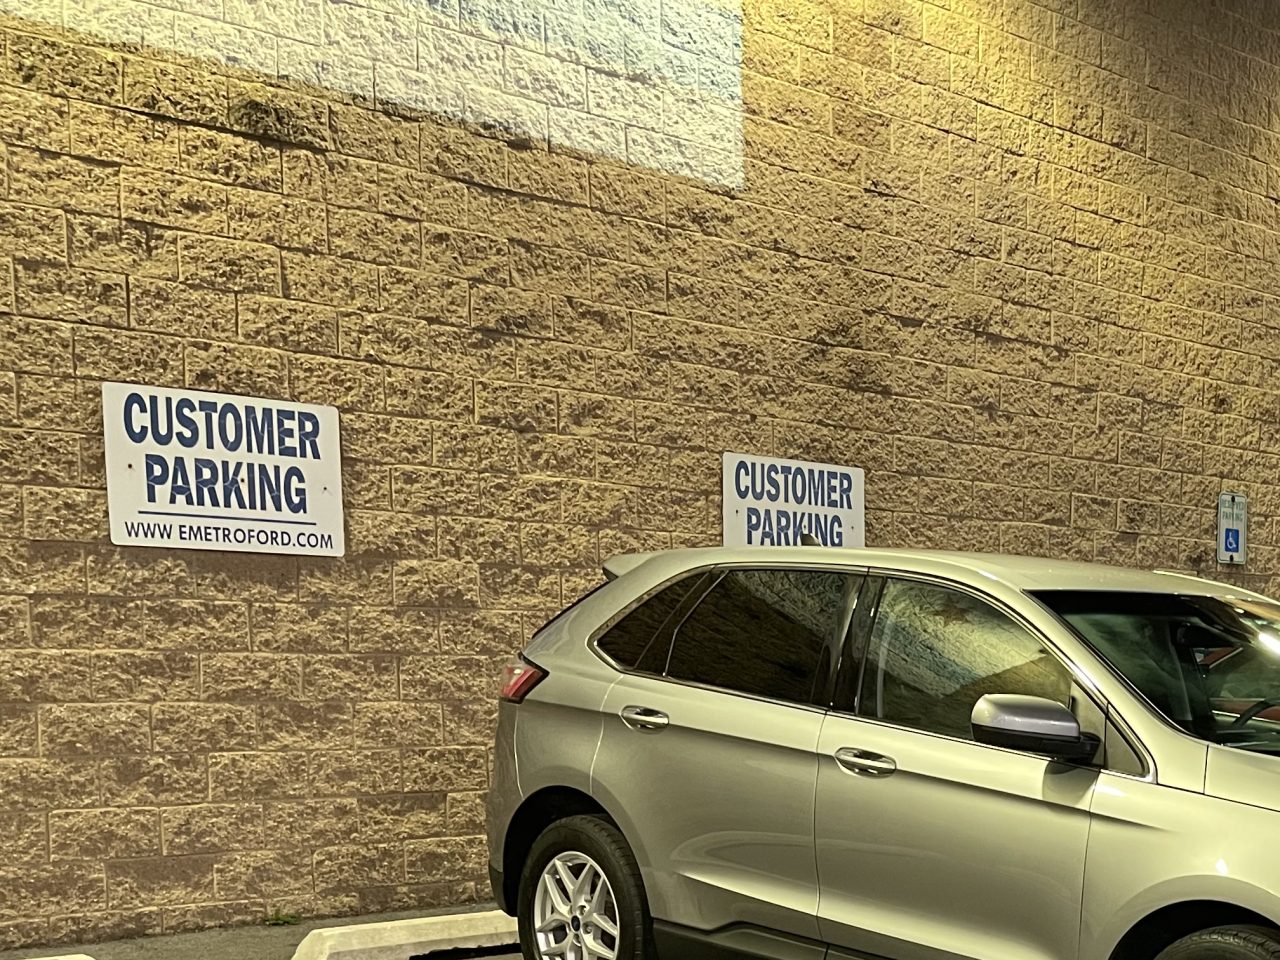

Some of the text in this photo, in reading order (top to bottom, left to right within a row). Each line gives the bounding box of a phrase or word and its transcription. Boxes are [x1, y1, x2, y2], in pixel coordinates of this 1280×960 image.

[123, 392, 321, 460] CUSTOMER
[145, 453, 307, 514] PARKING
[735, 460, 853, 510] CUSTOMER
[178, 524, 334, 550] EMETROFORD.COM
[746, 507, 843, 547] PARKING
